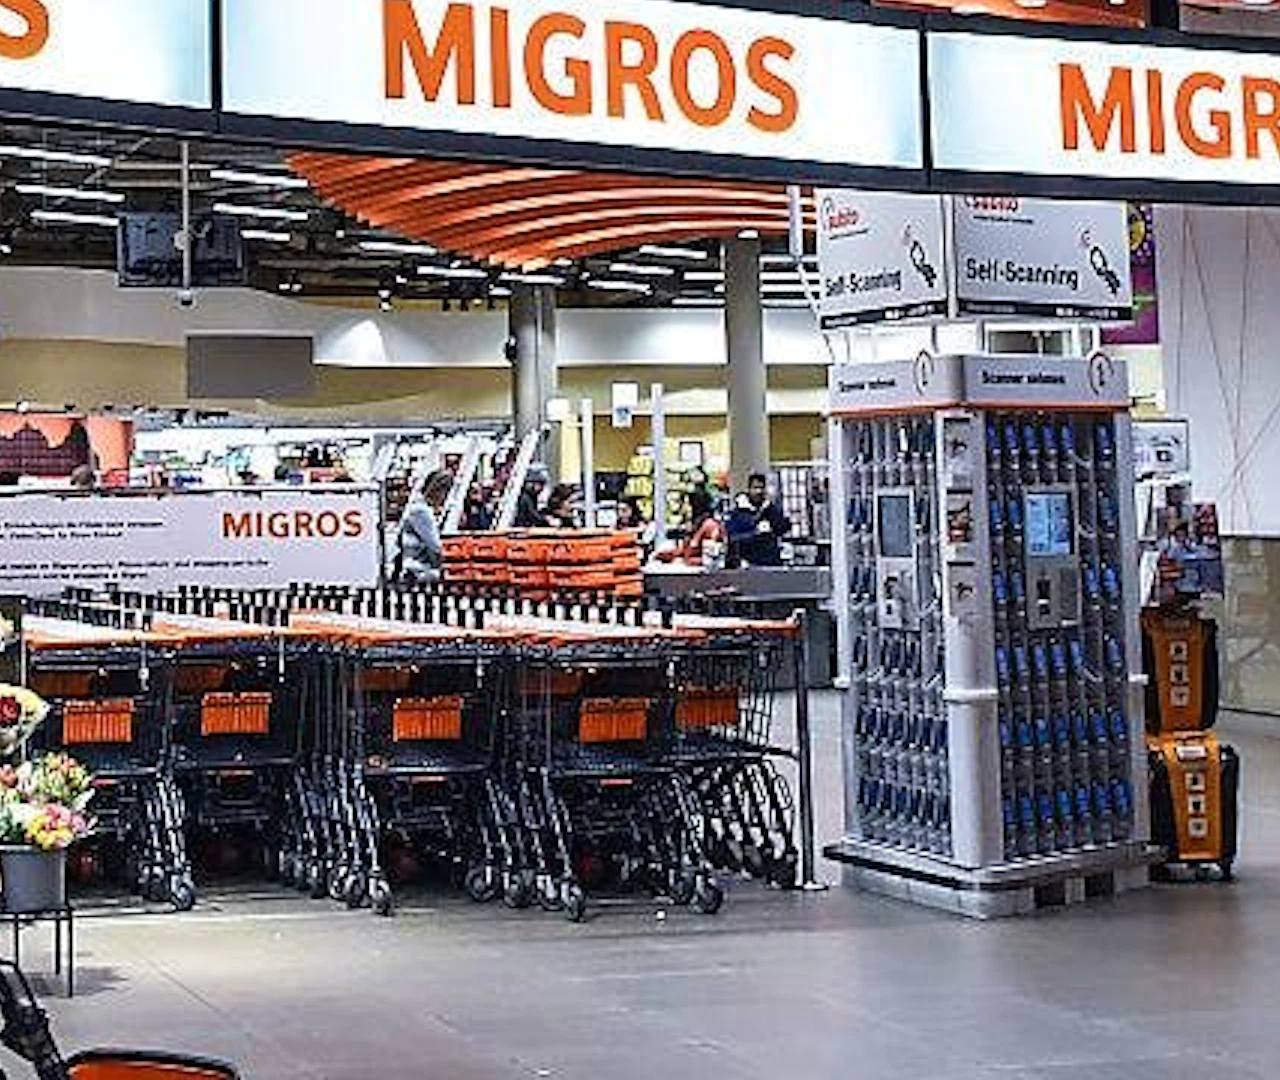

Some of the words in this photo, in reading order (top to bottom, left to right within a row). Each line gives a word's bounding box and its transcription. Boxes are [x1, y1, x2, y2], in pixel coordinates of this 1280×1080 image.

[825, 266, 902, 297] Self-Scanning
[966, 258, 1079, 291] Self-Scanning
[222, 510, 363, 538] MIGROS
